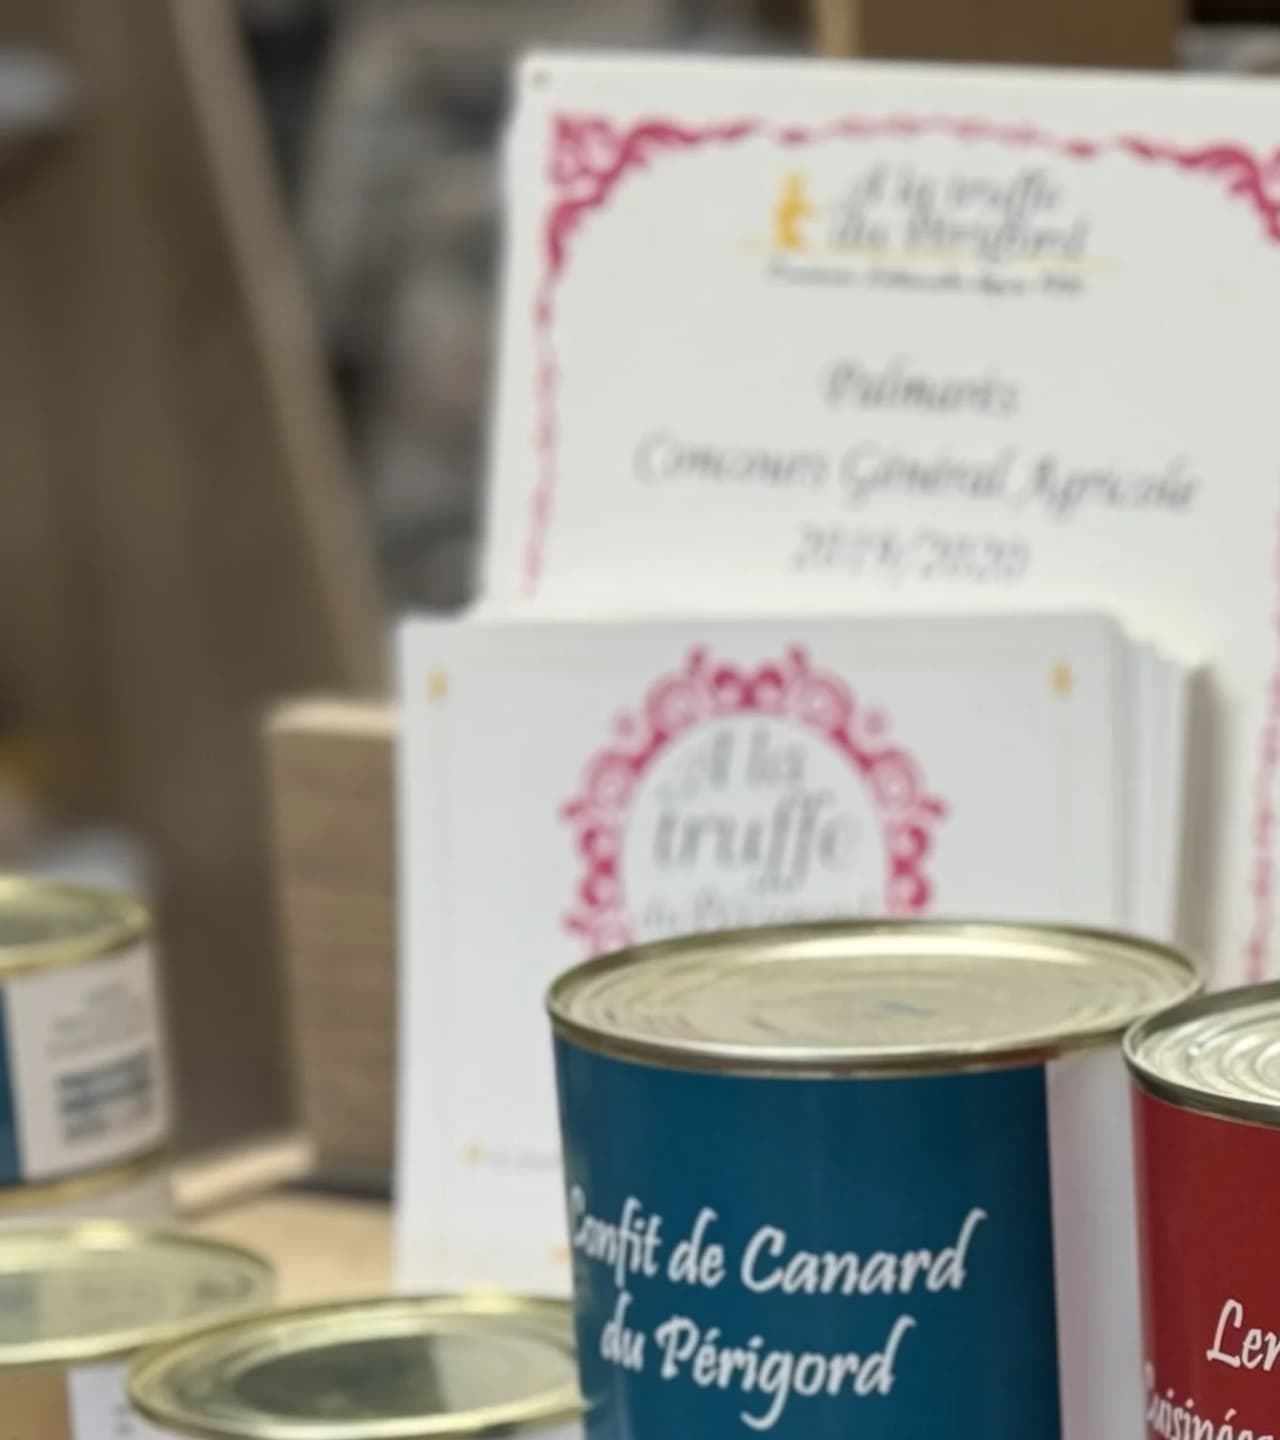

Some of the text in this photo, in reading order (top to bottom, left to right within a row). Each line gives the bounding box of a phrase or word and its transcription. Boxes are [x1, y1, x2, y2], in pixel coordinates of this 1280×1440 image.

[667, 1206, 726, 1289] de
[741, 1206, 987, 1295] Canard
[600, 1291, 917, 1431] du Périgord
